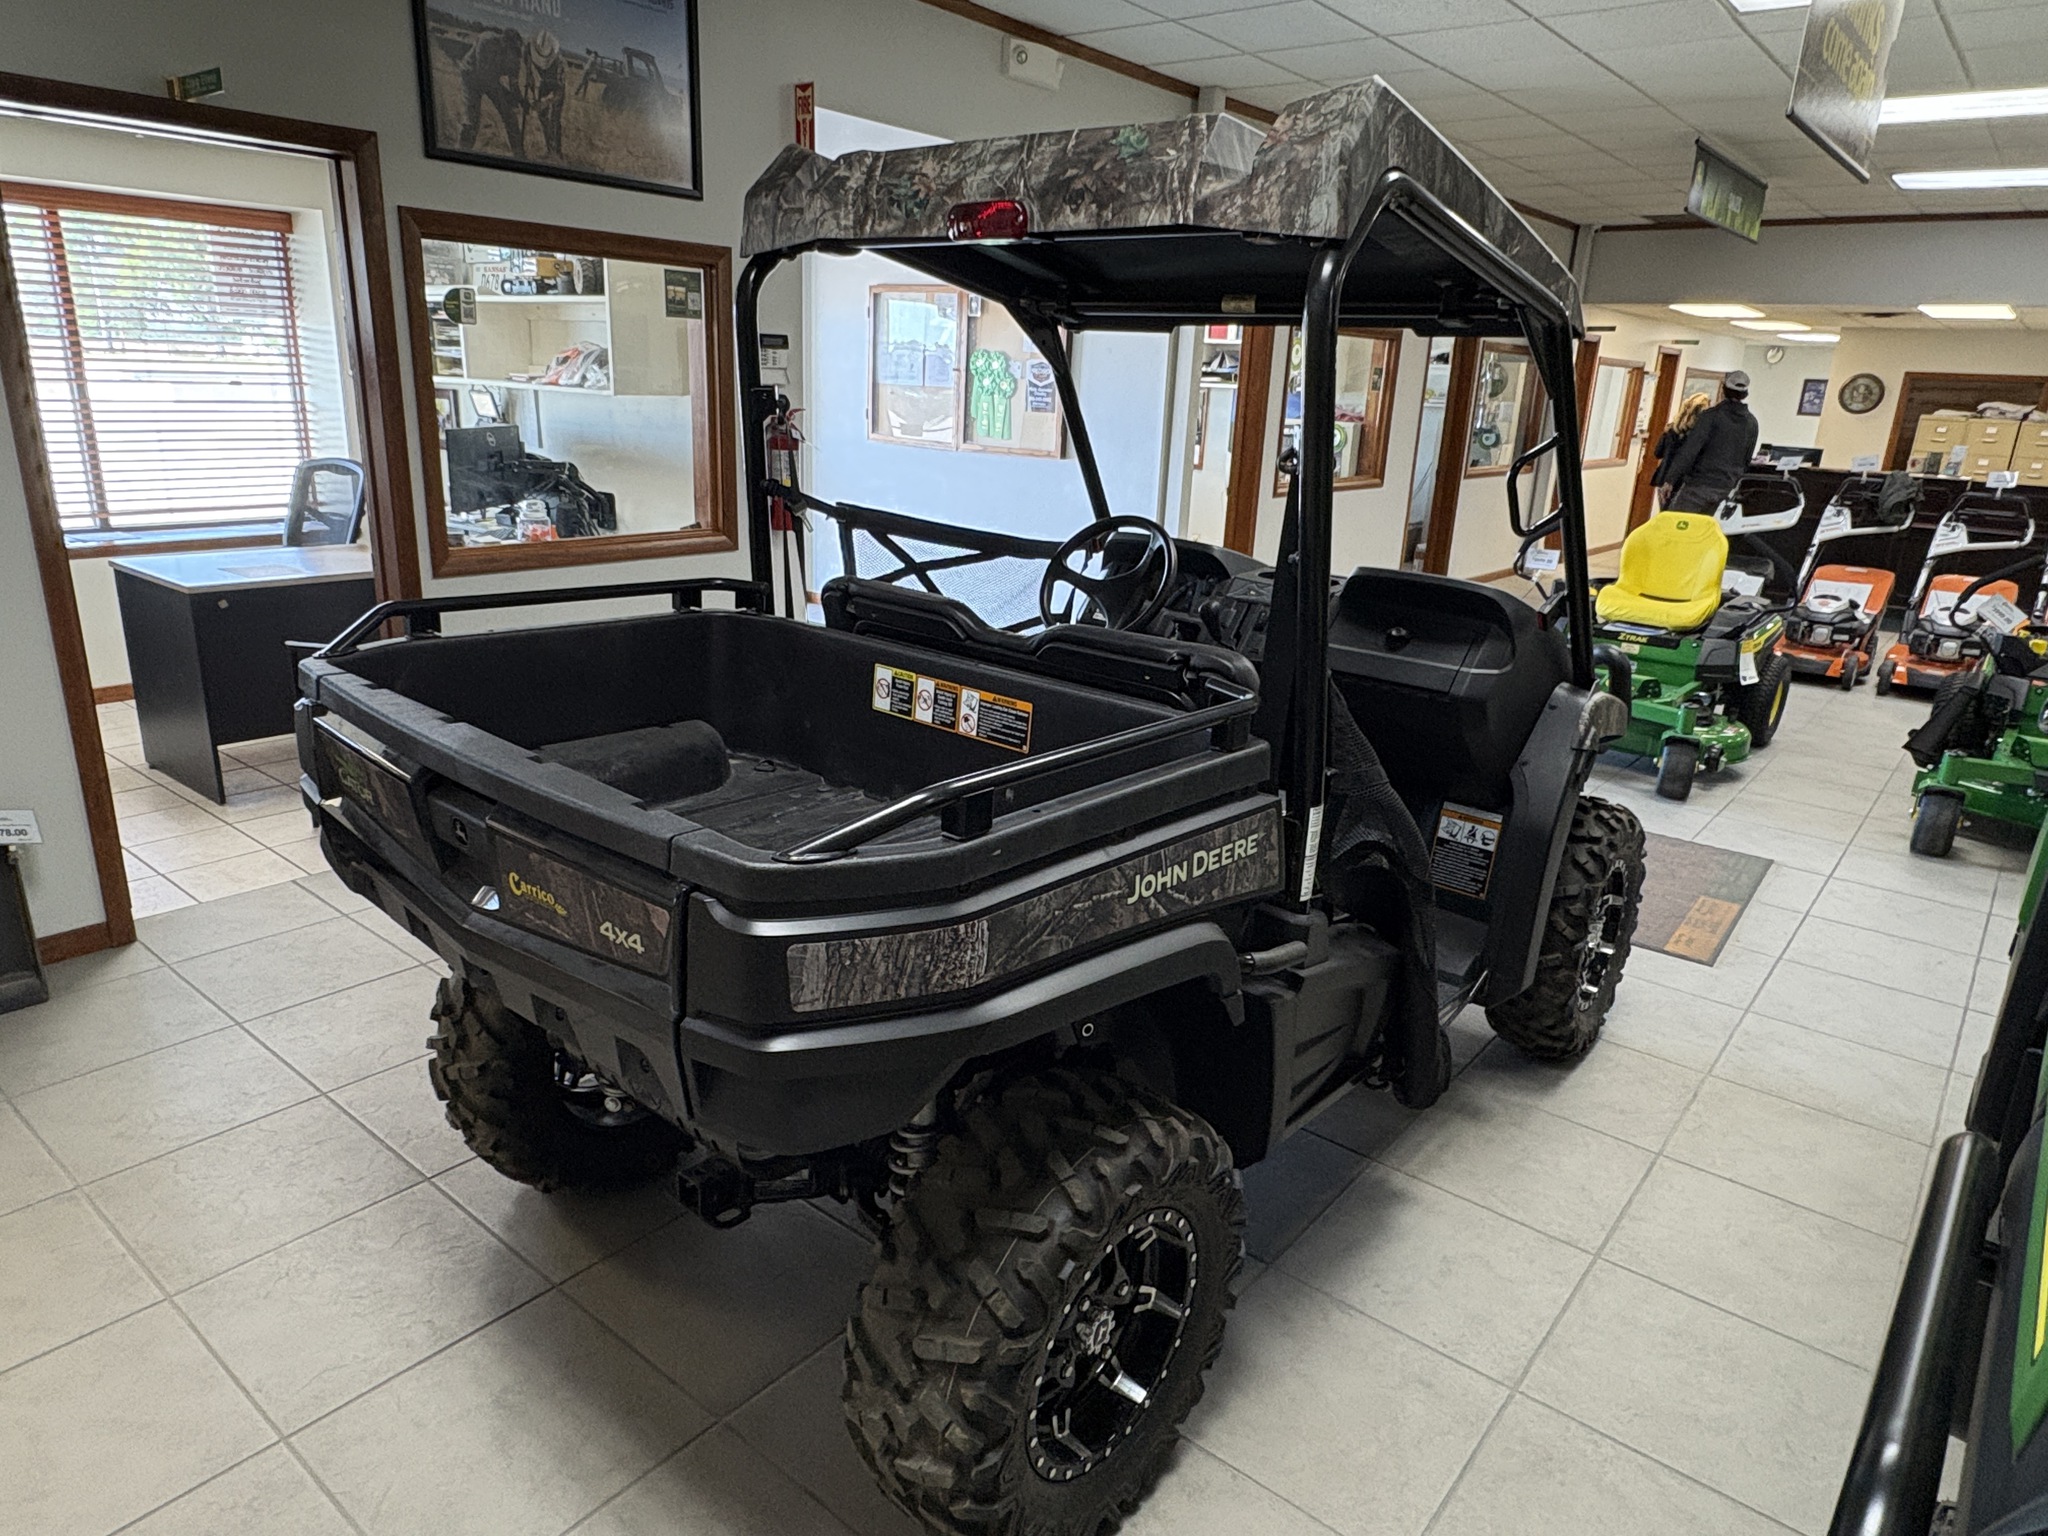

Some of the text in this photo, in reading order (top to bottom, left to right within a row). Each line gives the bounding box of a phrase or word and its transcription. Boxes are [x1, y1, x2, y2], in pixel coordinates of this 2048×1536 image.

[797, 94, 811, 115] FIRE
[1127, 861, 1188, 905] JOHN
[1192, 833, 1259, 878] DEERE
[508, 872, 555, 905] Carrico
